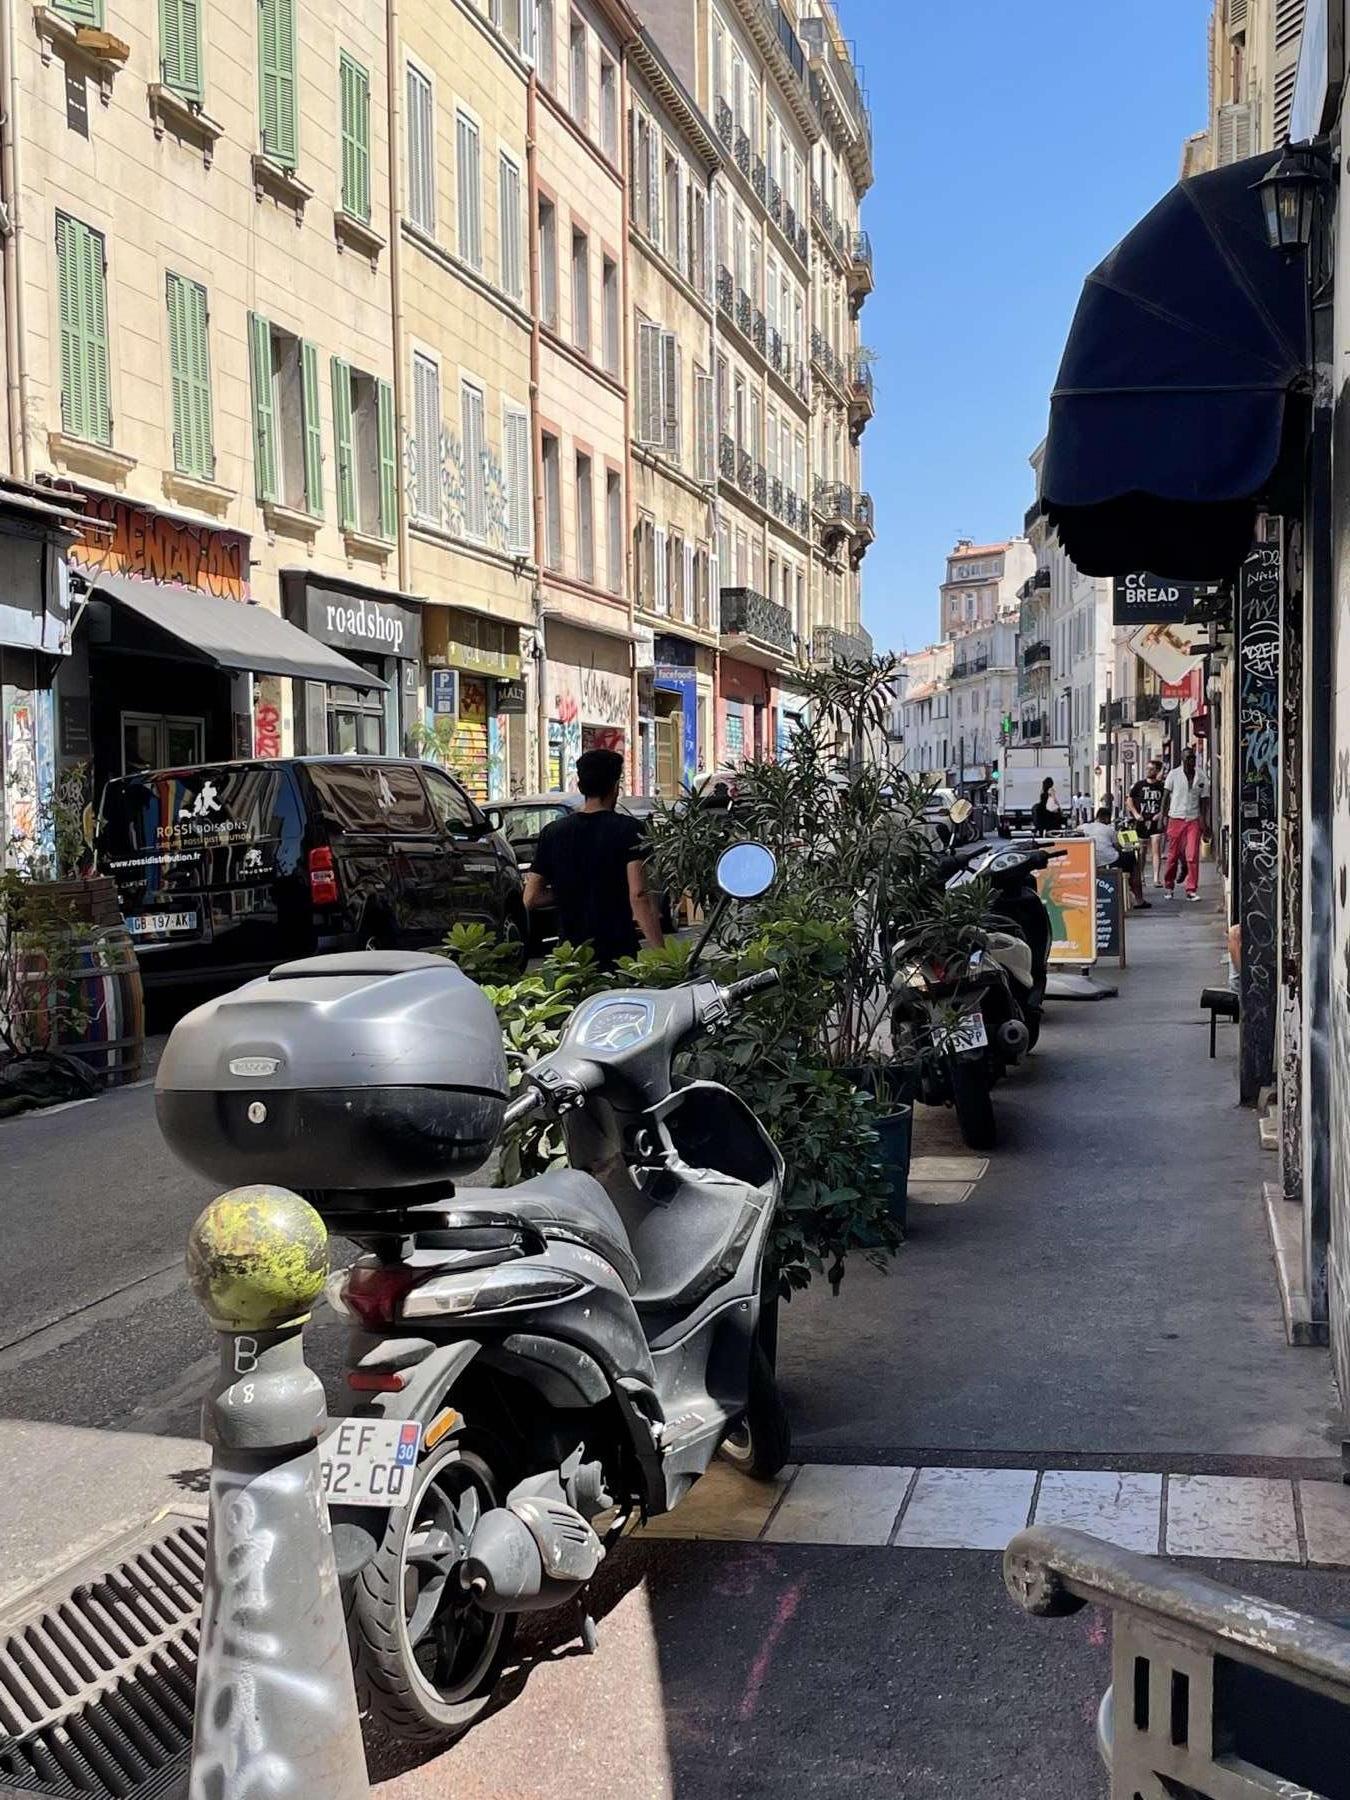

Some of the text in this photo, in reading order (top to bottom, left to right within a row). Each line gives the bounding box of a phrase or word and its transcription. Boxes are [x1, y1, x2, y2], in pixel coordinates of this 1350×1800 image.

[1126, 587, 1179, 603] BREAD
[326, 600, 404, 652] roadshop
[440, 673, 450, 688] P
[156, 820, 248, 838] ROSSI BOISSONS
[109, 852, 201, 869] www.rossidistribution.fr
[234, 1336, 259, 1374] B
[398, 1444, 414, 1461] 30
[320, 1461, 405, 1496] 92-CQ
